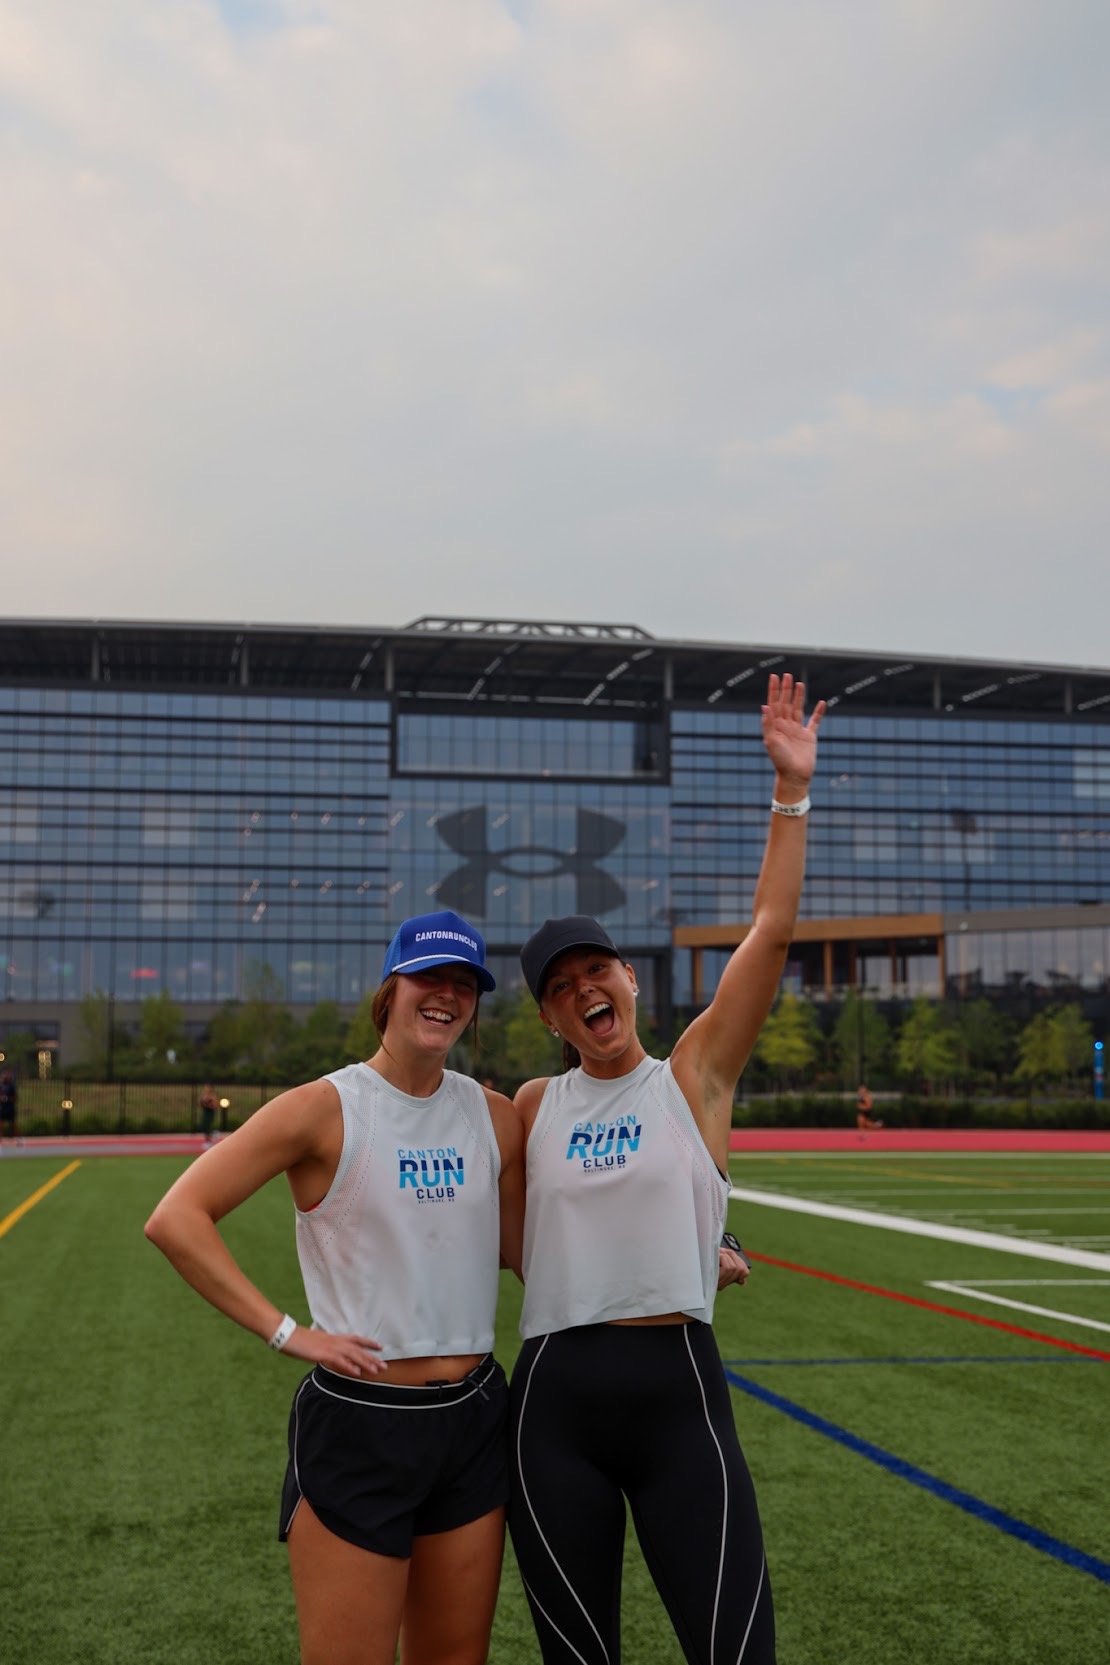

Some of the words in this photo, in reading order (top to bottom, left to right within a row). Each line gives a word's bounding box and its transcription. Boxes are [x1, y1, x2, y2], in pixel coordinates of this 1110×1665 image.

[415, 931, 478, 951] CANTONRUNCLUB
[566, 1124, 642, 1159] RUN
[398, 1147, 457, 1159] CANTON
[583, 1155, 626, 1168] CLUB
[399, 1157, 464, 1188] RUN
[416, 1187, 455, 1199] CLUB
